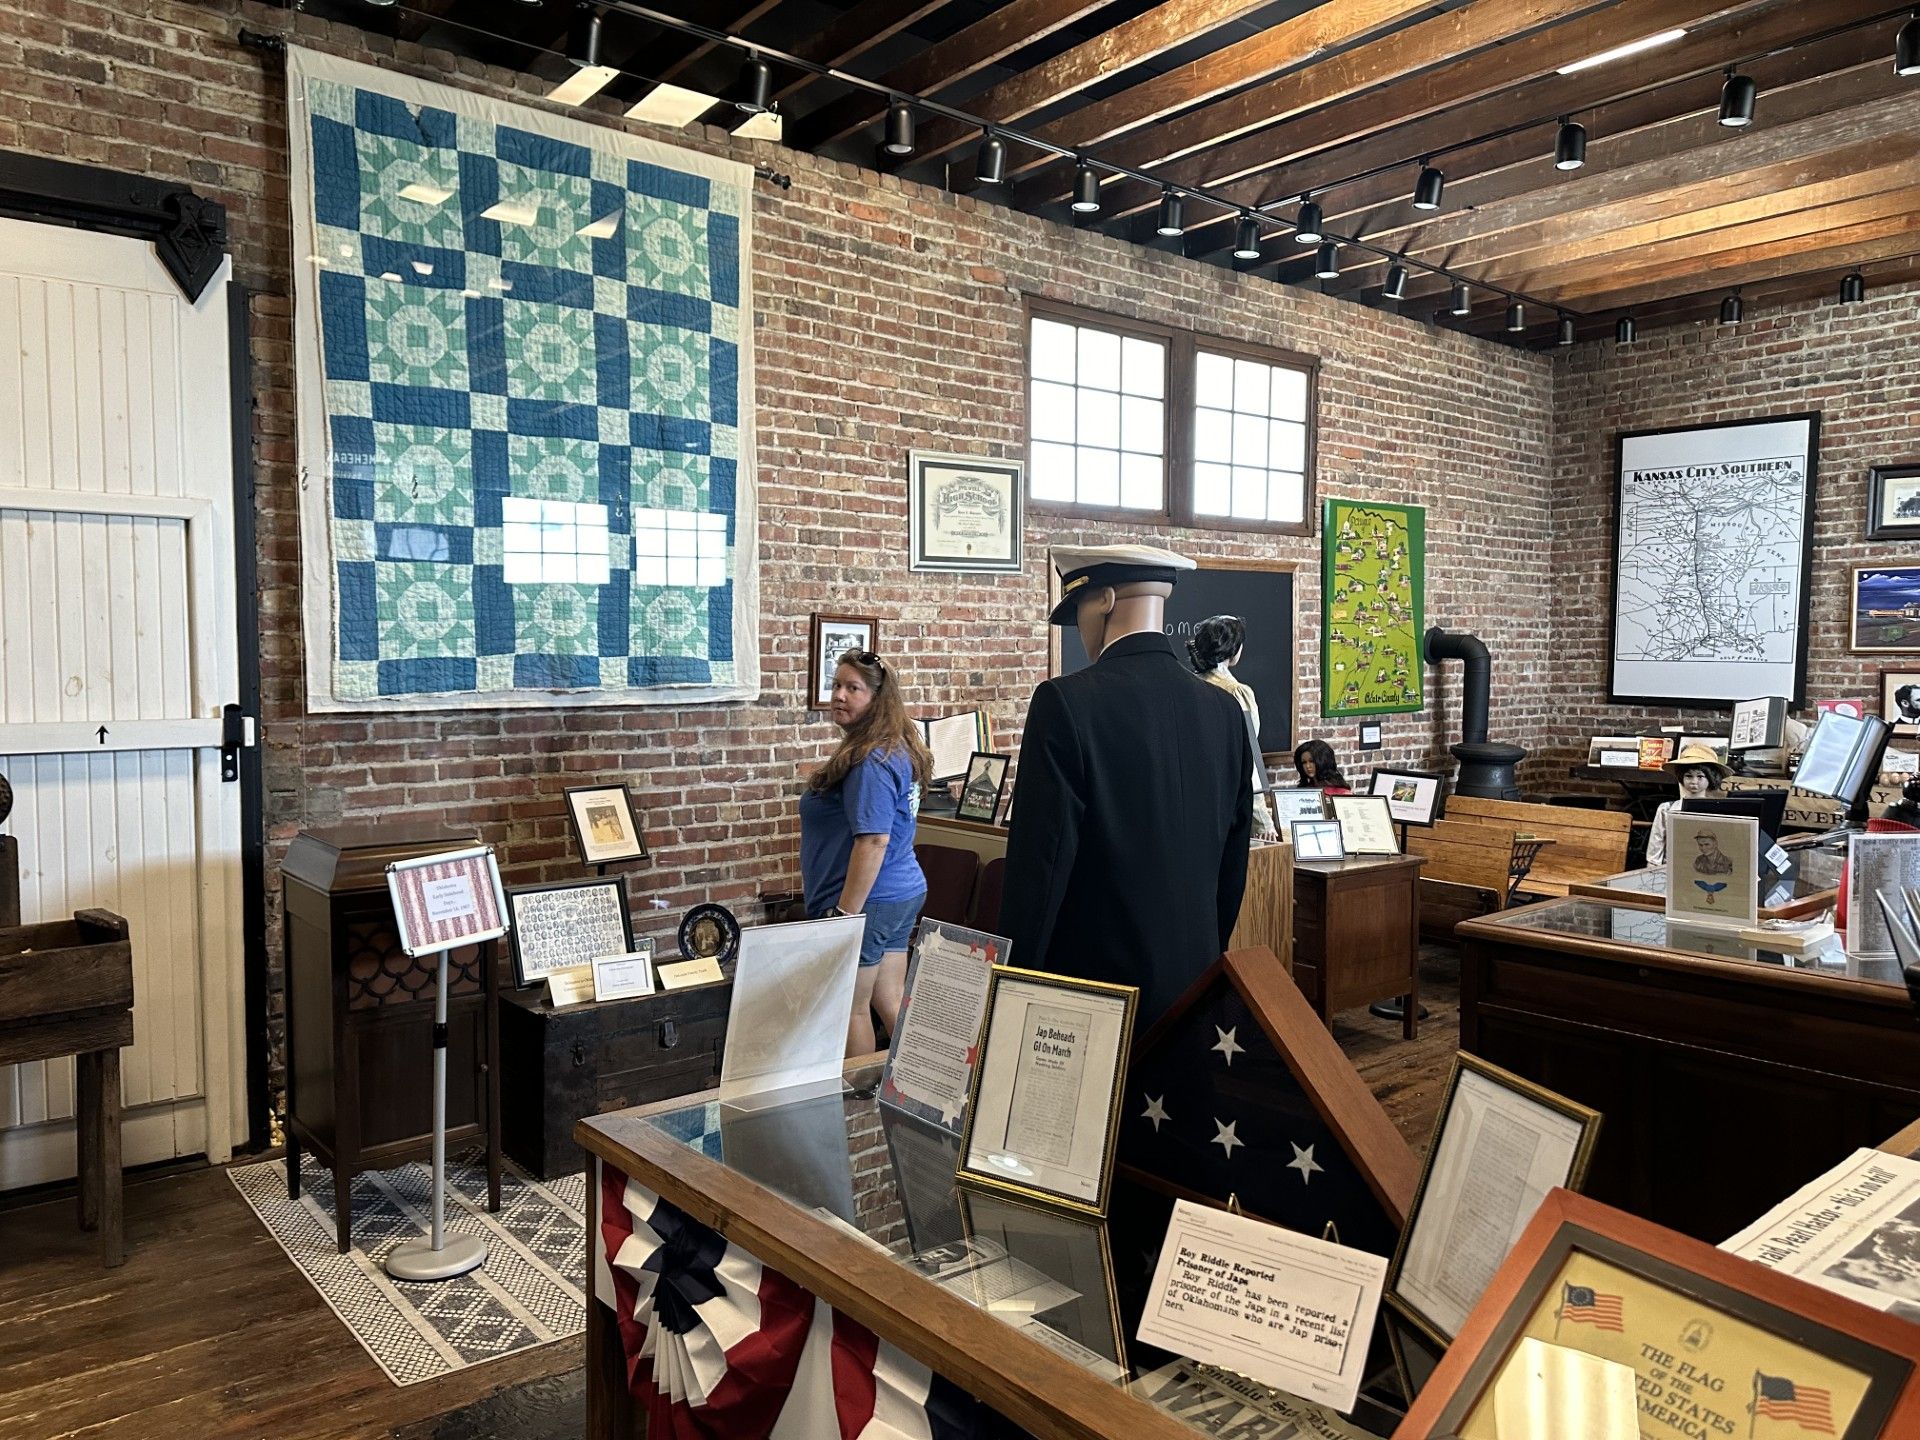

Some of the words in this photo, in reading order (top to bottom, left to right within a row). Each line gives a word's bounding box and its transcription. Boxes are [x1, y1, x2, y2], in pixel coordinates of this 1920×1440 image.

[1633, 470, 1684, 482] KANSAS
[1686, 466, 1717, 478] CITY
[1721, 461, 1792, 475] SOUTHERN
[1165, 621, 1202, 636] ome
[1718, 781, 1742, 792] CK
[1035, 1025, 1047, 1039] Jap
[1048, 1028, 1075, 1043] Beheads
[1033, 1040, 1041, 1051] GI
[1042, 1042, 1051, 1054] On
[1052, 1044, 1072, 1058] March
[1770, 1225, 1816, 1247] Pearl
[1176, 1257, 1213, 1274] Prisoner
[1215, 1270, 1226, 1278] of
[1227, 1273, 1249, 1286] Japs
[1180, 1247, 1196, 1259] Roy
[1200, 1253, 1230, 1268] Riddle
[1233, 1263, 1275, 1282] Reported
[1170, 1279, 1207, 1295] prisoner
[1210, 1291, 1222, 1300] of
[1225, 1294, 1241, 1306] the
[1245, 1301, 1267, 1314] Japs
[1269, 1308, 1280, 1318] in
[1294, 1316, 1326, 1332] recent
[1329, 1325, 1346, 1338] list
[1182, 1270, 1201, 1283] Roy
[1207, 1278, 1238, 1293] Riddle
[1245, 1289, 1262, 1301] has
[1267, 1295, 1289, 1309] been
[1295, 1305, 1337, 1323] reported
[1342, 1319, 1349, 1327] a
[1168, 1289, 1178, 1298] of
[1182, 1292, 1239, 1317] Oklahomans
[1244, 1312, 1263, 1324] who
[1268, 1320, 1284, 1330] are
[1289, 1325, 1308, 1339] Jap
[1641, 1343, 1674, 1369] THE
[1677, 1362, 1725, 1392] FLAG
[1650, 1368, 1668, 1380] OF
[1670, 1377, 1694, 1395] THE
[1635, 1373, 1662, 1397] TED
[1664, 1392, 1736, 1434] STATES
